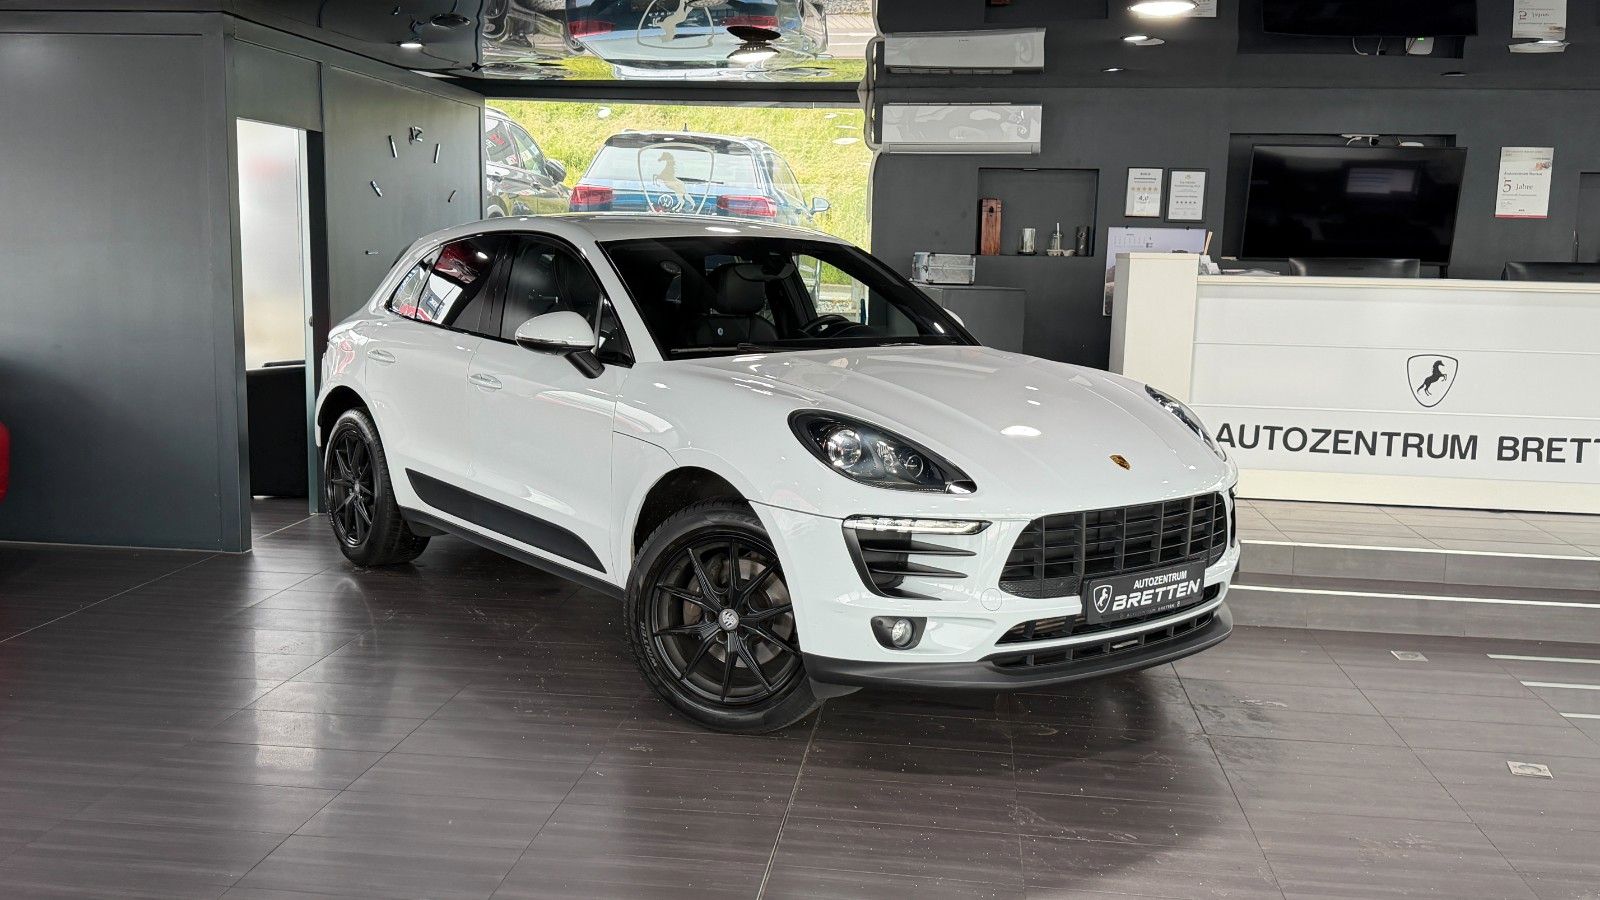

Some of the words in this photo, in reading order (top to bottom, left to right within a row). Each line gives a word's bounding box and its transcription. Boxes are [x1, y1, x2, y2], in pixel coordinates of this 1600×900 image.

[1502, 179, 1512, 192] 5
[1216, 423, 1478, 460] AUTOZENTRUM
[1497, 436, 1600, 464] BRET
[1133, 570, 1188, 590] AUTOZENTRUM
[1112, 578, 1201, 612] BRETTEN
